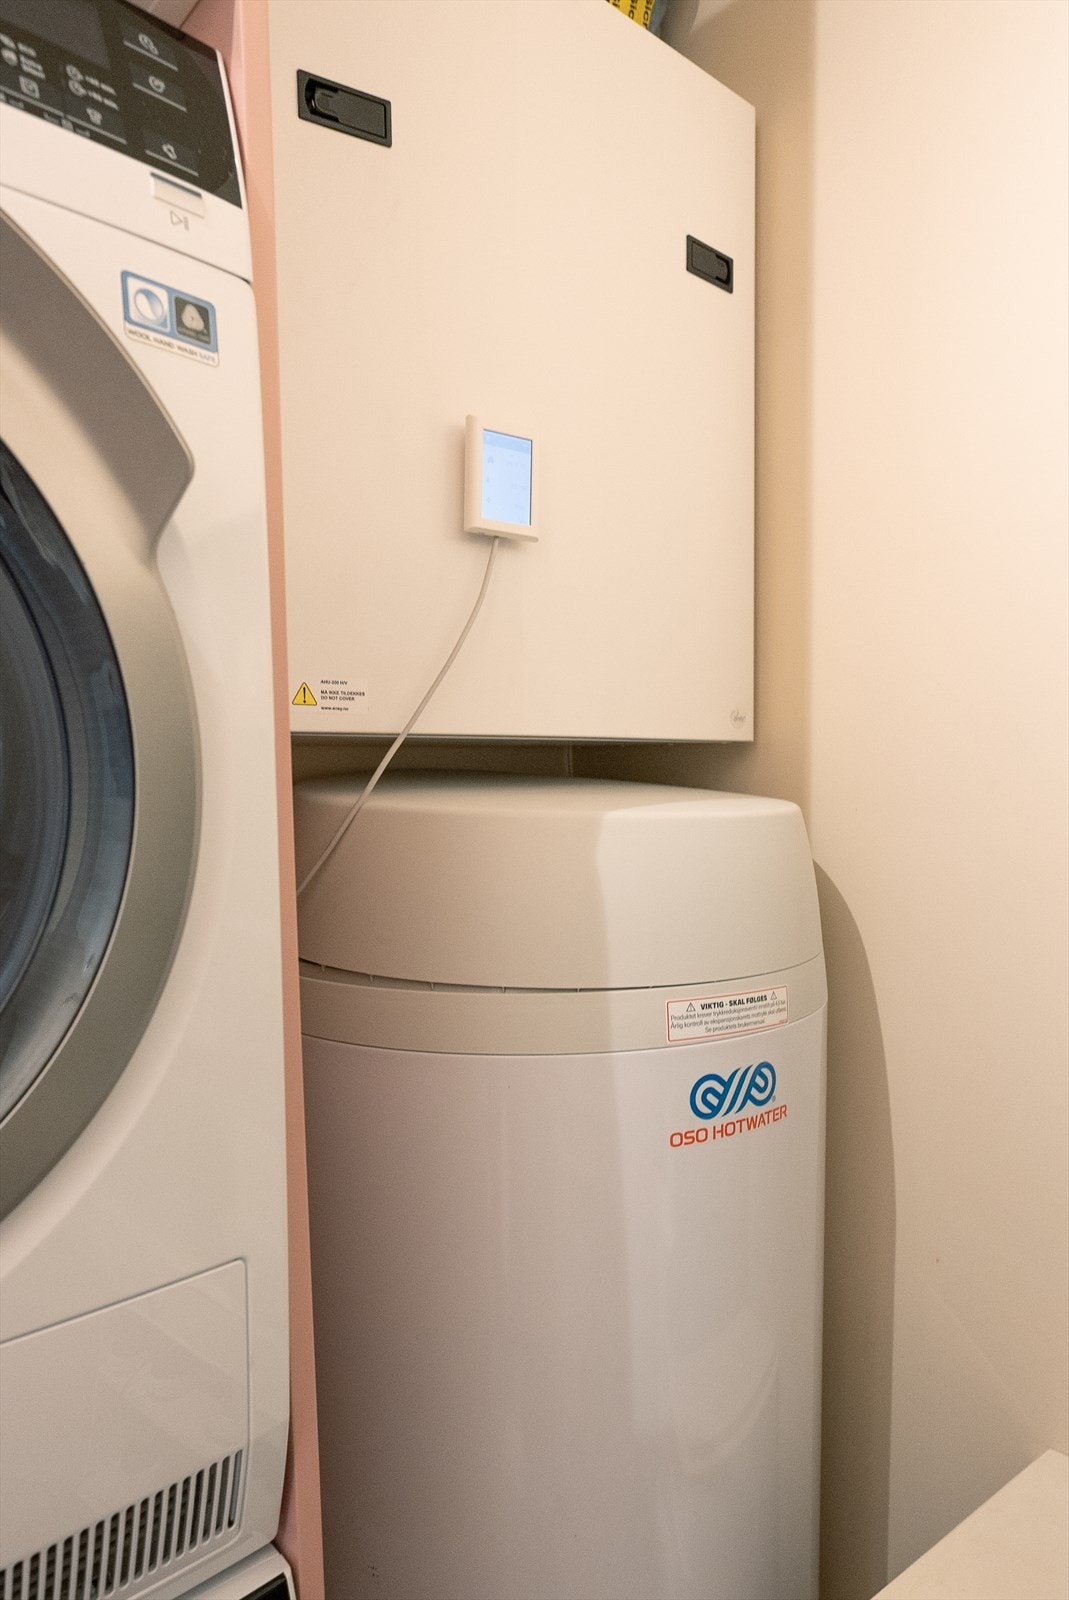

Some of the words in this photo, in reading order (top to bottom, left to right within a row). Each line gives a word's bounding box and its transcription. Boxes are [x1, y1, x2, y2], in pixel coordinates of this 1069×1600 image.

[153, 336, 175, 349] HAND
[176, 345, 198, 356] WASH
[700, 1001, 724, 1010] VIKTIG
[728, 998, 745, 1007] SKAL
[746, 994, 768, 1004] FØLGES
[670, 1013, 696, 1021] Produktet
[669, 1127, 709, 1148] OSO
[712, 1104, 787, 1140] HOTWATER
